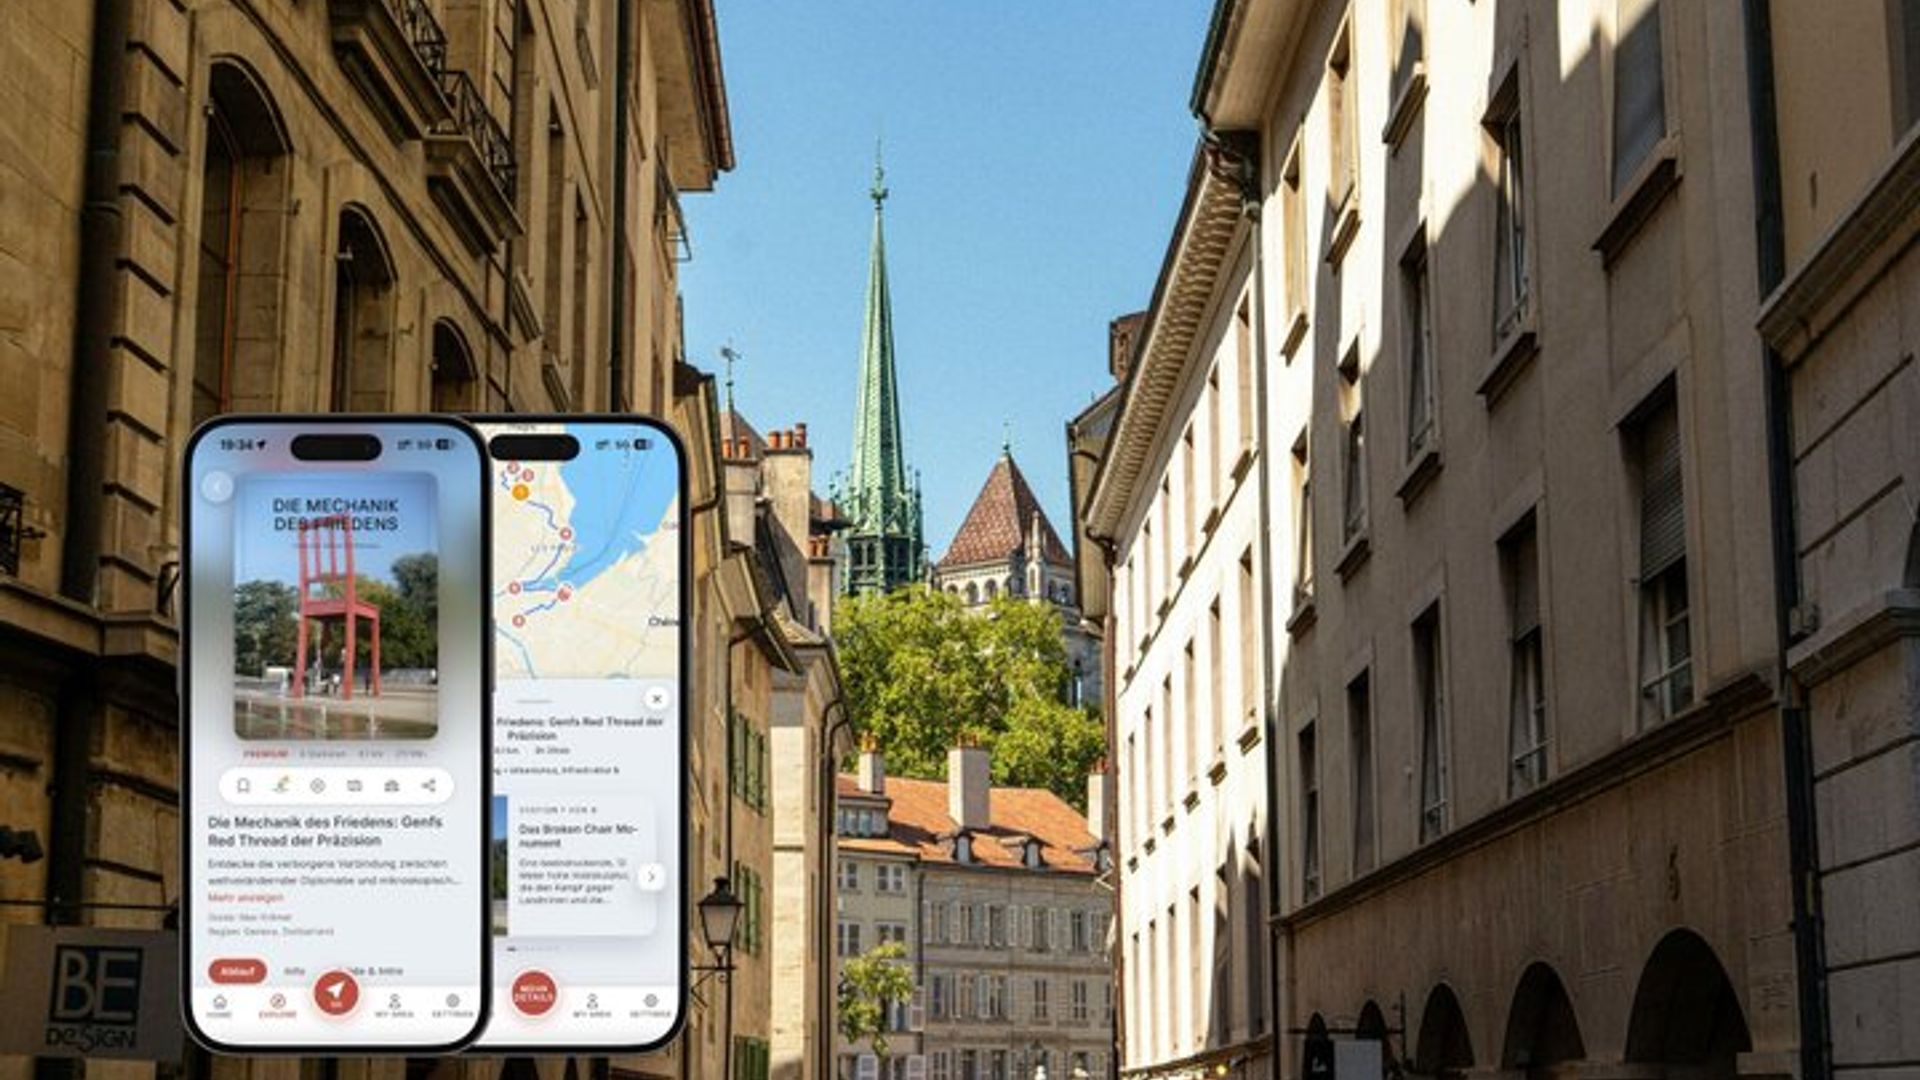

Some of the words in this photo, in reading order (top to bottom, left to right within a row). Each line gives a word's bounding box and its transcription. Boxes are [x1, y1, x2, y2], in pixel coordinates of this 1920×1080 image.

[273, 499, 299, 514] DIE
[306, 499, 399, 514] MECHANIK
[274, 516, 309, 531] DES
[314, 516, 399, 531] FRIEDENS
[607, 716, 643, 726] Thread
[208, 816, 230, 829] Die
[234, 815, 301, 829] Mechanik
[305, 815, 330, 829] des
[334, 815, 397, 829] Friedens:
[401, 815, 443, 829] Genfs
[584, 824, 613, 835] Chair
[208, 834, 235, 847] Red
[239, 834, 287, 847] Thread
[291, 834, 314, 847] der
[317, 833, 382, 847] Präzision
[208, 859, 255, 869] Entdecke
[337, 859, 395, 871] Verbindung
[358, 876, 377, 886] und
[54, 949, 139, 1020] BE
